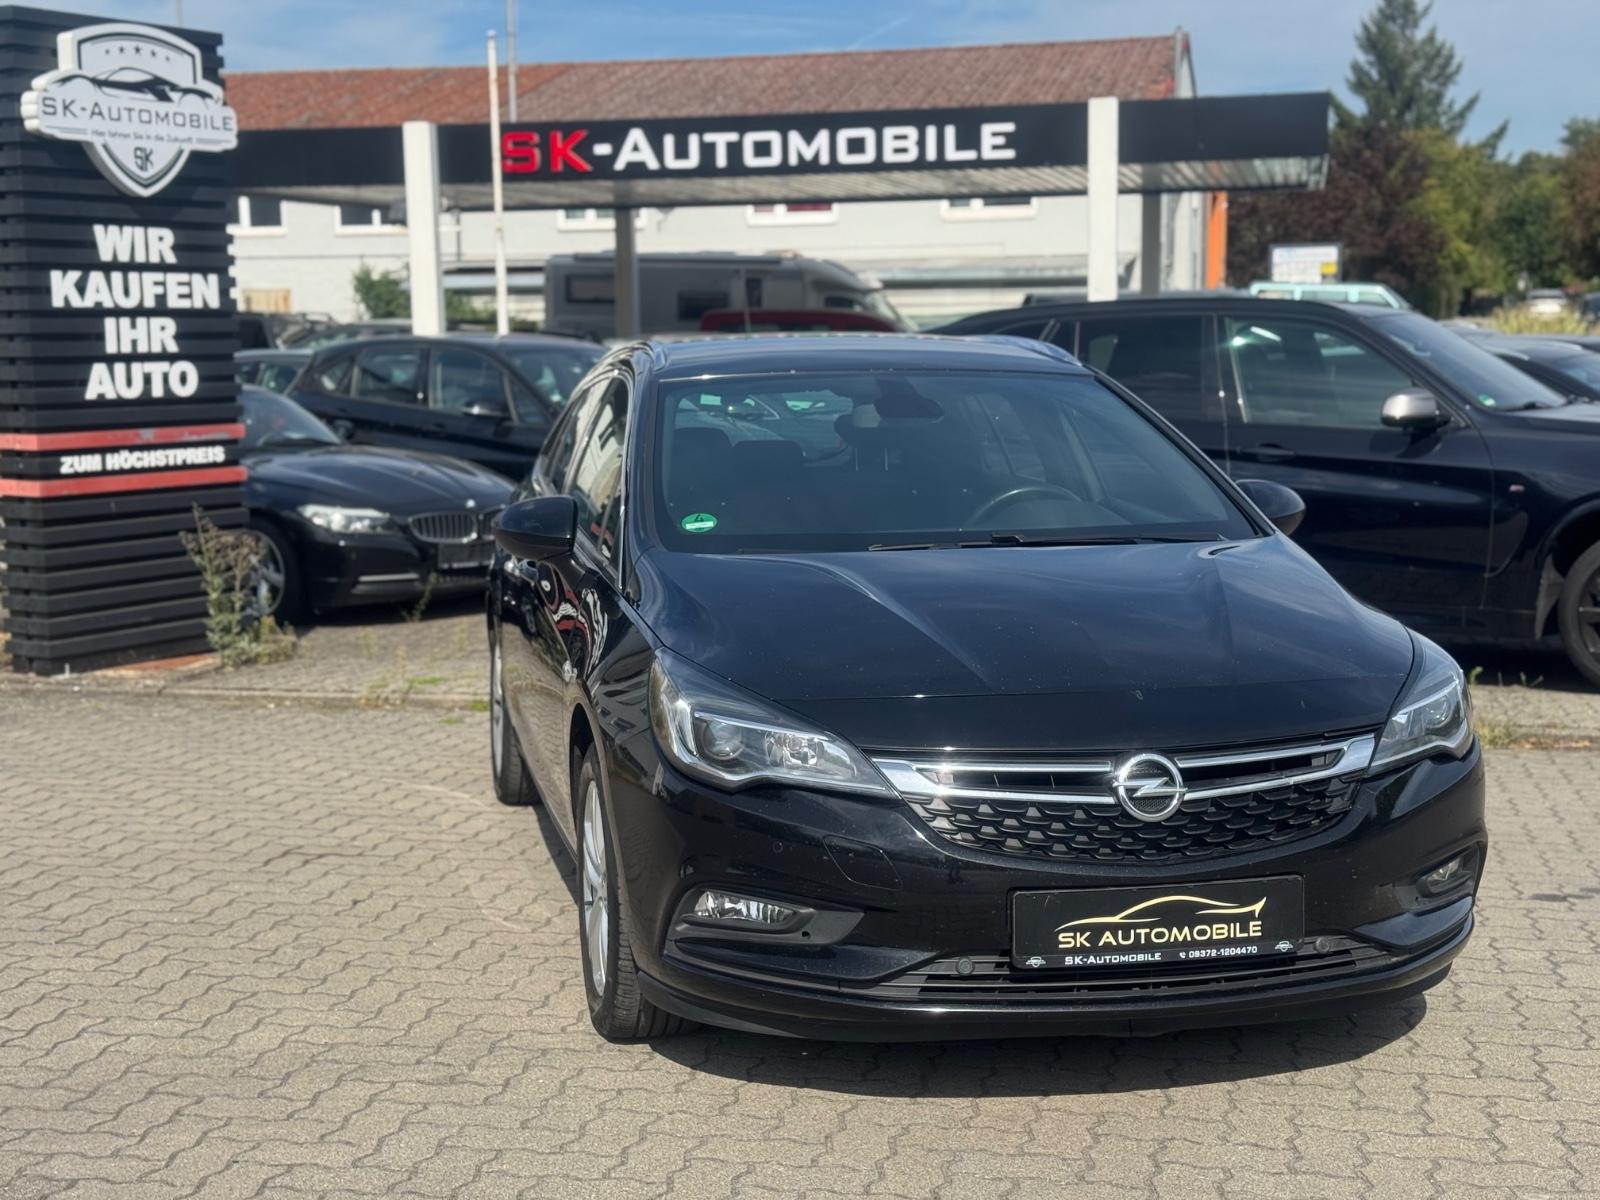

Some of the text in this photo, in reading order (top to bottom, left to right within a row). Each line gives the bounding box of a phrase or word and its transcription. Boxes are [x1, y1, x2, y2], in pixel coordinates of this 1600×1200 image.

[42, 97, 233, 131] SK-AUTOMOBILE
[134, 147, 154, 172] SK
[501, 121, 1017, 173] SK-AUTOMOBILE
[93, 224, 177, 264] WIR
[50, 269, 220, 309] KAUFEN
[104, 316, 179, 354] IHR
[84, 360, 199, 400] AUTO
[59, 445, 226, 474] ZUM HÖCHSTPREIS
[1058, 920, 1263, 949] SK AUTOMOBILE
[1064, 945, 1258, 966] SK-AUTOMOBILE 09372-1204470
